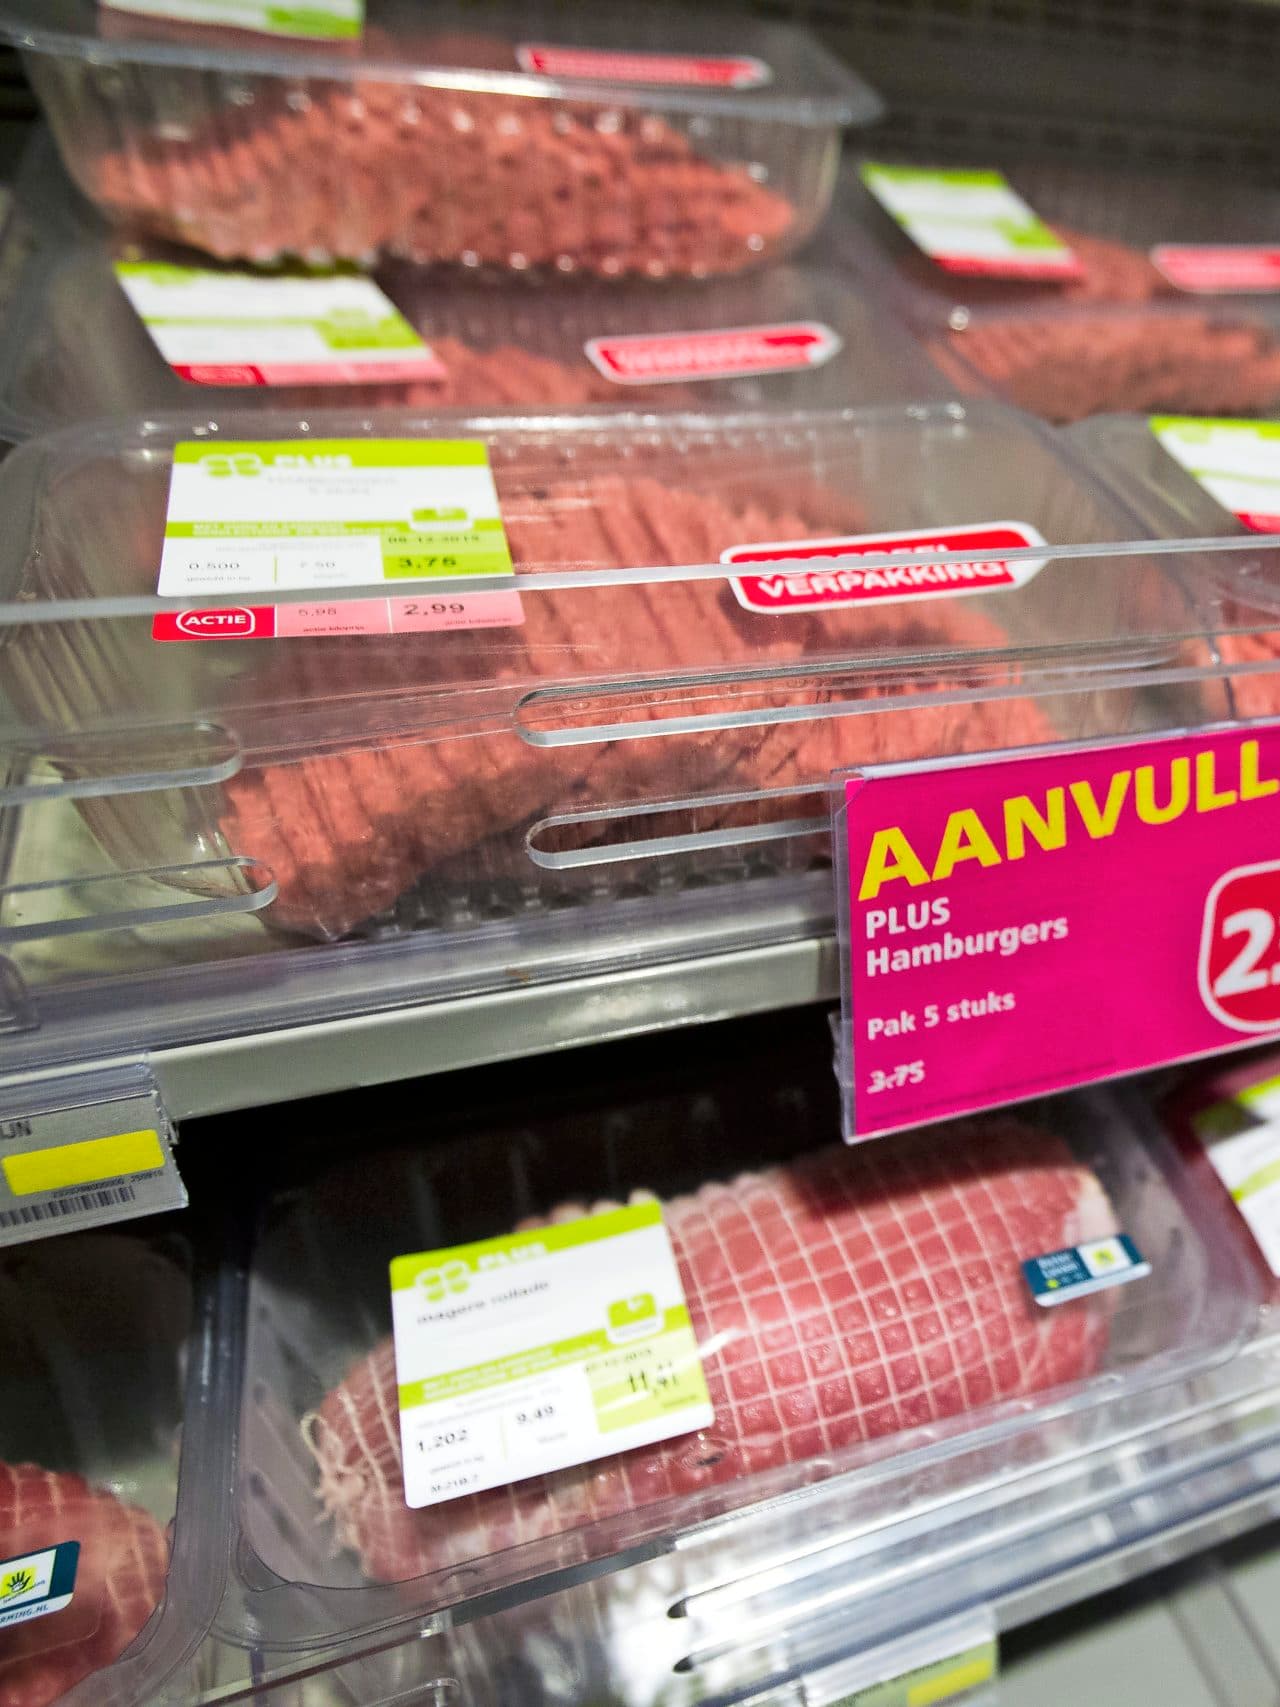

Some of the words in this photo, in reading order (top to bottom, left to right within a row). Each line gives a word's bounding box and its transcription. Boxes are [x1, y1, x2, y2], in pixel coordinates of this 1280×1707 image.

[758, 560, 1001, 598] VERPAKKING
[184, 613, 247, 626] ACTIE
[865, 897, 951, 939] PLUS
[865, 917, 1070, 977] Hamburgers
[866, 1003, 916, 1041] Pak
[924, 1003, 941, 1028] 5
[946, 989, 1016, 1023] stuks
